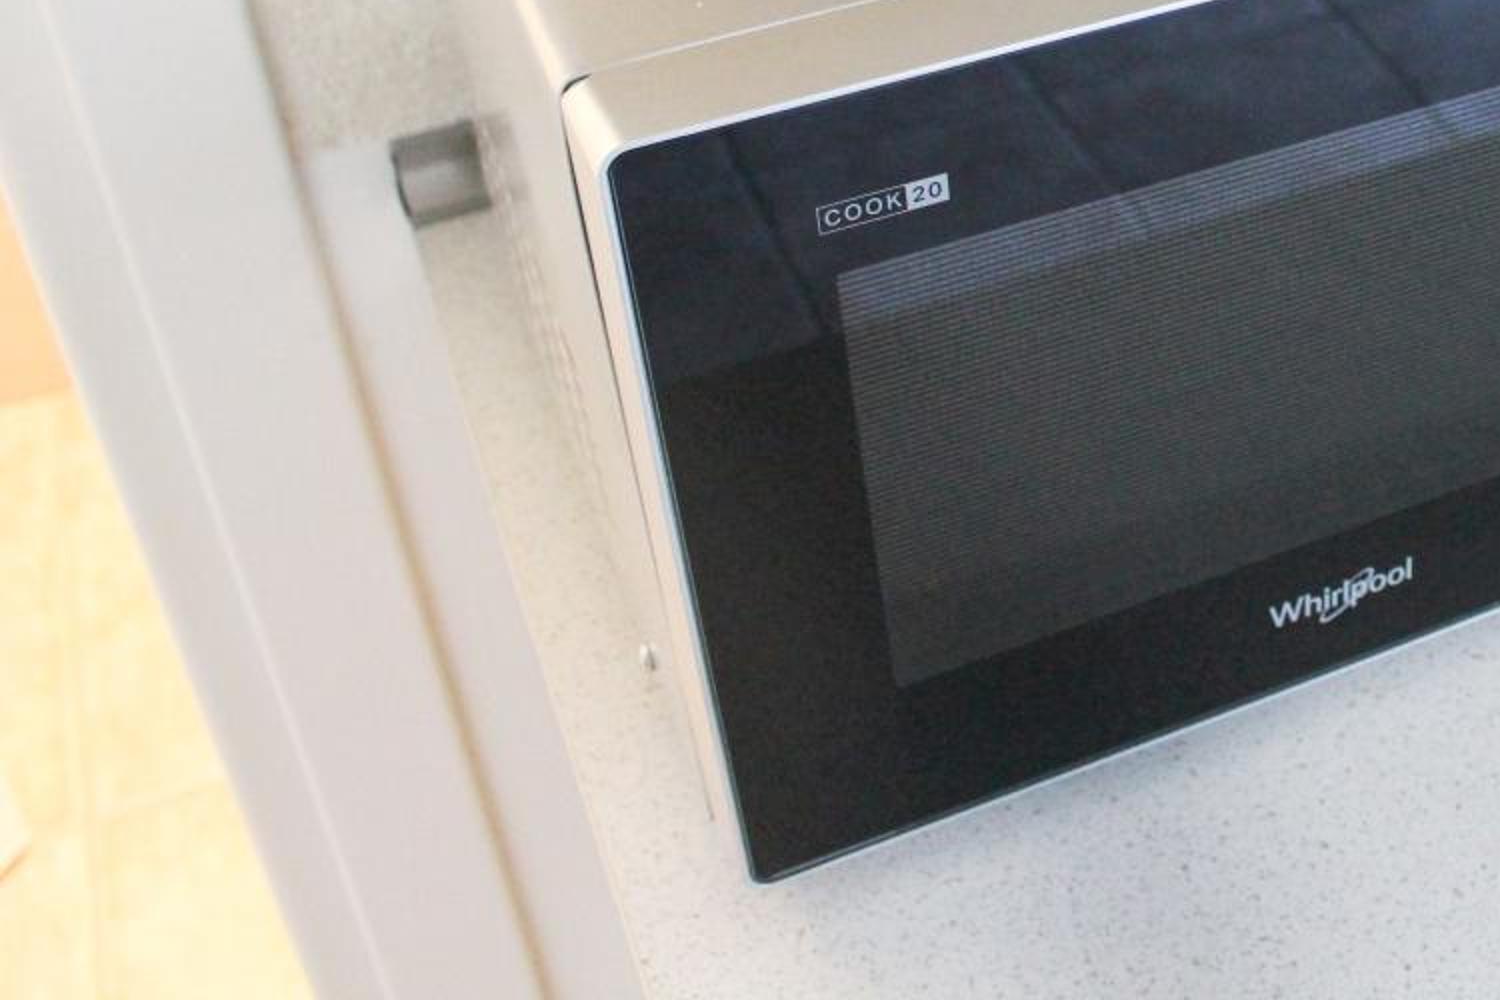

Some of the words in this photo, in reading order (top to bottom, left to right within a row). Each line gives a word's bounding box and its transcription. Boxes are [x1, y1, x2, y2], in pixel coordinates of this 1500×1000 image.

[825, 191, 902, 226] COOK
[912, 181, 942, 203] 20
[1269, 556, 1413, 628] Whirlpool
